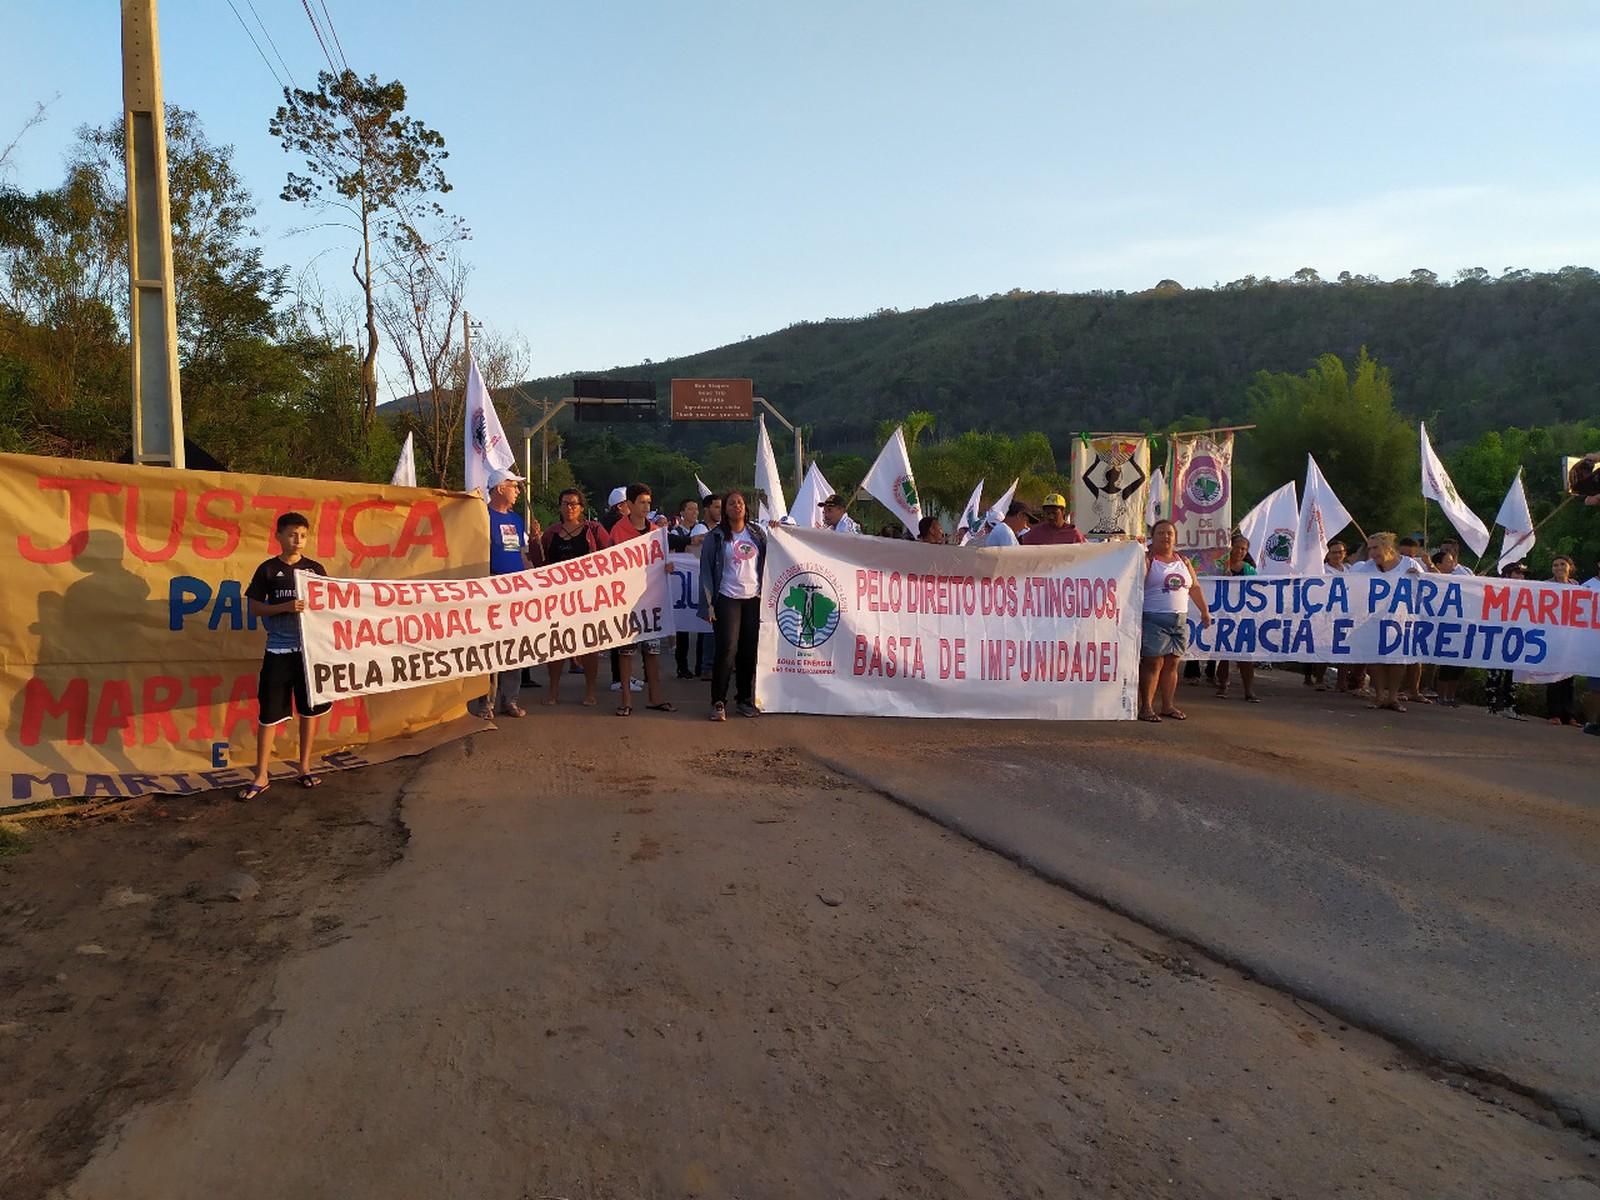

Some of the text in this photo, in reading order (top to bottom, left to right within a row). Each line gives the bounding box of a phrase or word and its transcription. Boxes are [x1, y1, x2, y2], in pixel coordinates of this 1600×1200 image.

[17, 476, 449, 569] JUSTIÇA
[1198, 518, 1214, 528] DE
[307, 538, 665, 611] EM DEFESA DA SOBERANIA
[856, 569, 902, 612] PELO
[907, 573, 975, 616] DIREITO
[980, 576, 1018, 617] DOS
[1022, 576, 1121, 625] ATINGIDOS,
[1208, 577, 1349, 619] JUSTIÇA
[1368, 578, 1463, 617] PARA
[332, 613, 482, 651] NACIONAL
[487, 604, 502, 630] E
[509, 580, 627, 628] POPULAR
[1332, 619, 1354, 654] E
[1378, 622, 1548, 665] DIREITOS
[313, 606, 662, 695] PELA REESTATIZAÇÃO DA VALE
[853, 634, 1119, 682] BASTA DE IMPUNIDADE!
[19, 674, 370, 747] MARIAA
[212, 742, 229, 768] E
